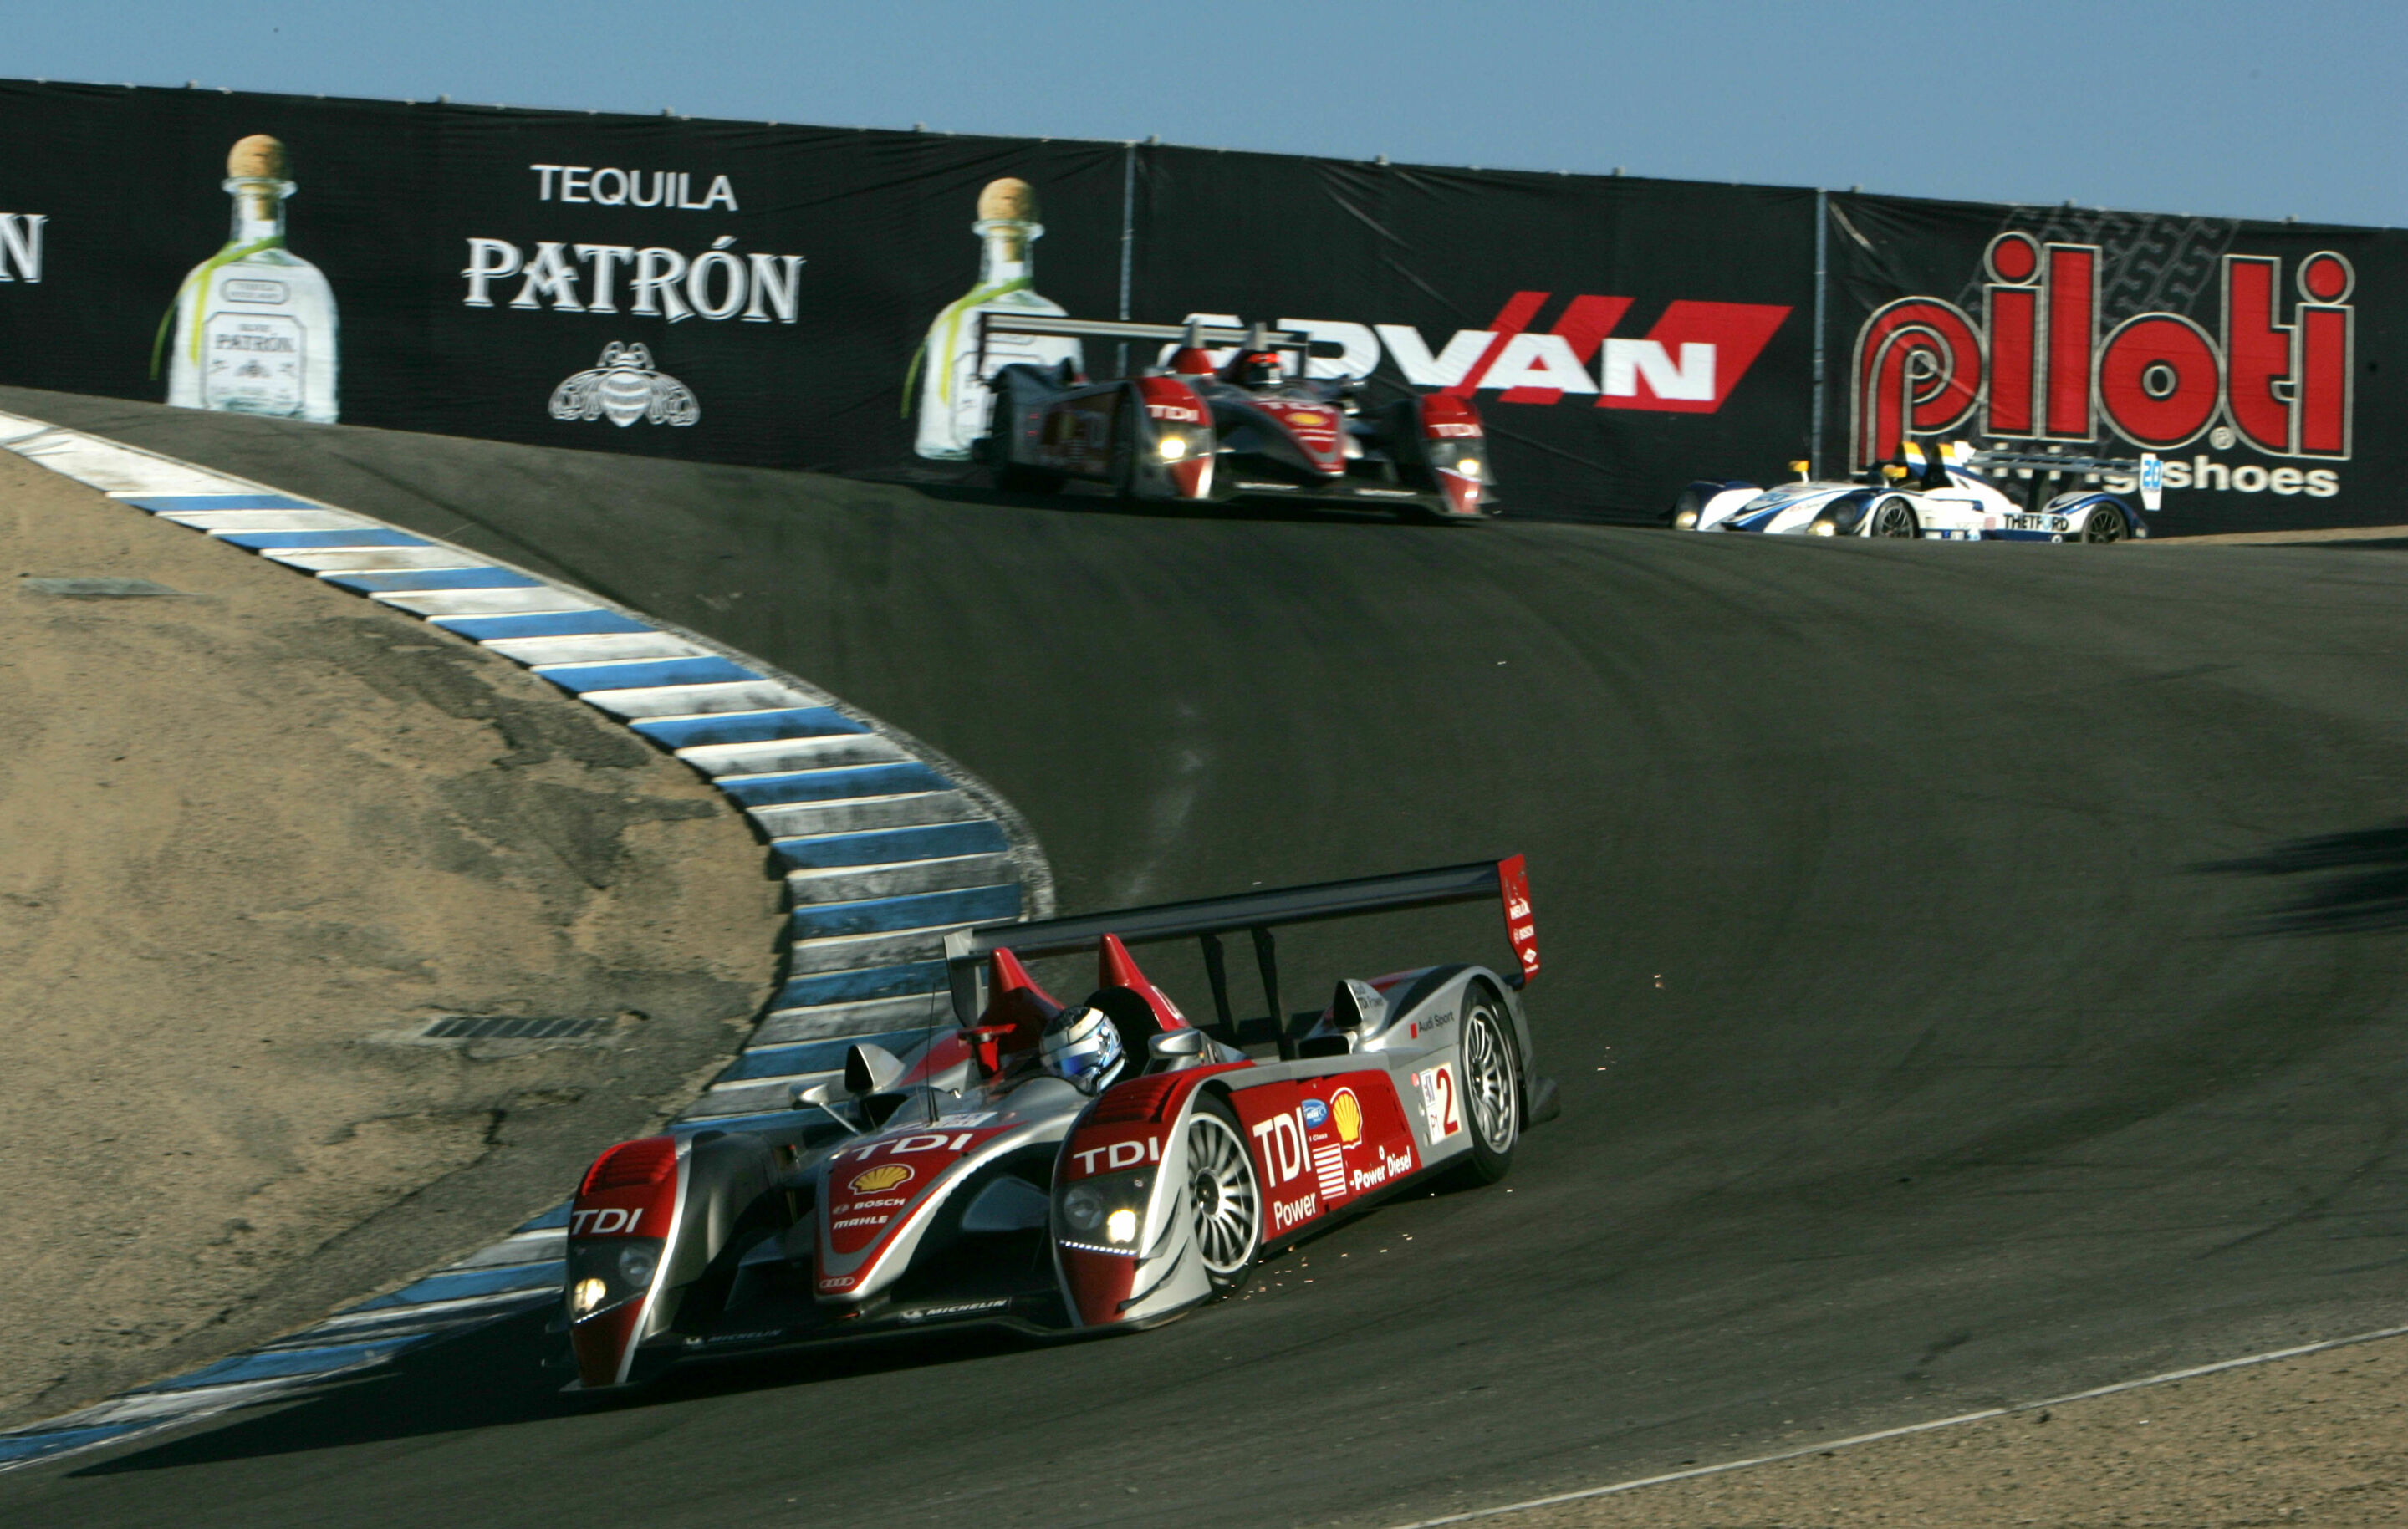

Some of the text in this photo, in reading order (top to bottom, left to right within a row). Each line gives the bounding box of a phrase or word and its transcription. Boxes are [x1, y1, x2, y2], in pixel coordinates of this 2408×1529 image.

[529, 164, 738, 212] TEQUILA
[460, 236, 805, 324] PATRÓN
[1849, 231, 2355, 474] piloti
[1145, 405, 1198, 421] TDI
[1429, 424, 1482, 437] TDI
[1436, 1068, 1459, 1136] 2
[852, 1134, 973, 1161] TDI
[1073, 1136, 1160, 1175] TDI
[1252, 1106, 1311, 1188] TDI
[1386, 1145, 1411, 1177] Diesel
[854, 1198, 906, 1210] BOSCH
[1273, 1192, 1316, 1231] Power
[571, 1207, 644, 1236] TDI
[833, 1215, 889, 1230] MAHLE
[926, 1299, 1008, 1316] MICHELIN
